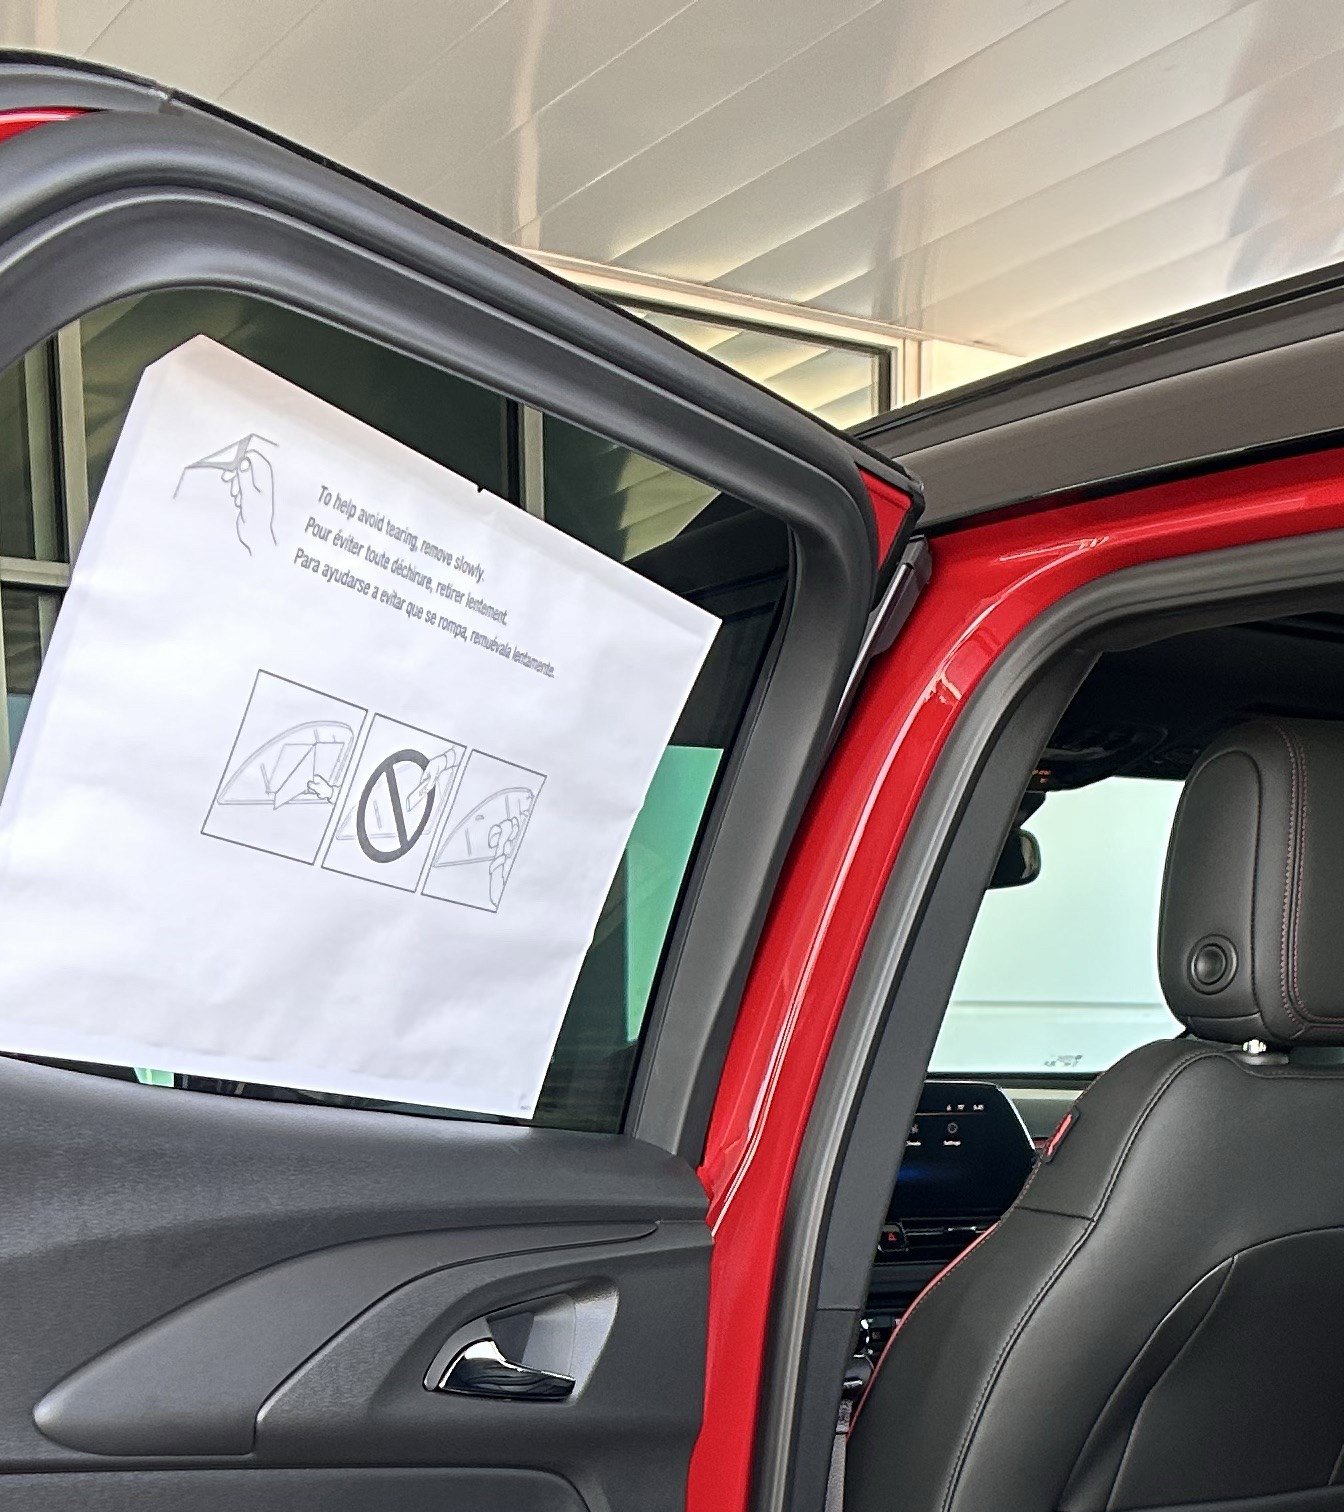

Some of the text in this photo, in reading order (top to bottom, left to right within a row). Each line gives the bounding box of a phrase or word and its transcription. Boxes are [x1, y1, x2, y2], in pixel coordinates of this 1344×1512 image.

[304, 516, 332, 541] Pour
[332, 529, 364, 557] éviter
[365, 545, 390, 570] toute
[436, 581, 465, 604] retirer
[317, 485, 332, 506] To
[333, 492, 356, 520] help
[358, 508, 385, 532] avoid
[386, 519, 418, 552] tearing,
[420, 540, 453, 566] remove
[294, 547, 320, 573] Para
[322, 563, 371, 595] ayudarse
[371, 585, 379, 600] a
[380, 590, 406, 610] evitar
[406, 601, 424, 619] que
[425, 610, 437, 625] se
[438, 615, 468, 642] rompa,
